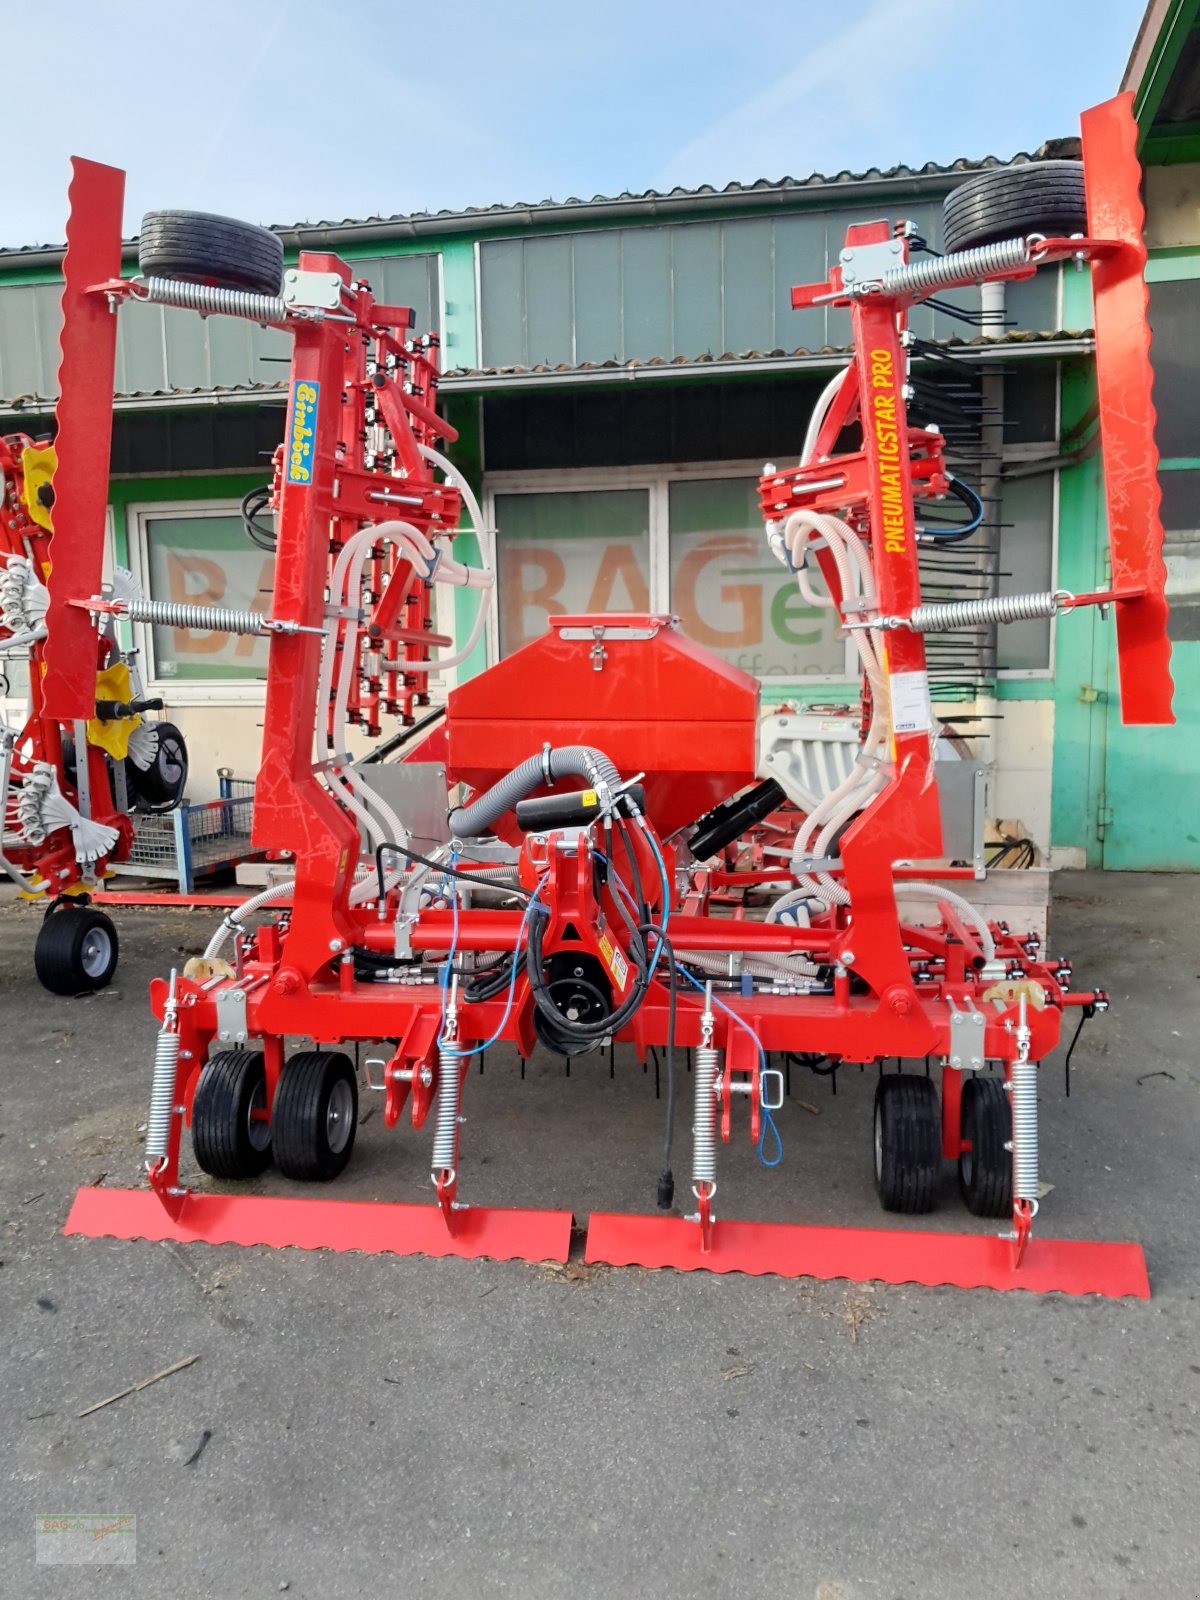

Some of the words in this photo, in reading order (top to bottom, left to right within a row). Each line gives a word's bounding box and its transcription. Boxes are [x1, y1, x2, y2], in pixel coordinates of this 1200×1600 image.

[870, 349, 894, 388] PRO
[290, 384, 317, 481] Einböck
[874, 395, 906, 553] PNEUMATICSTAR
